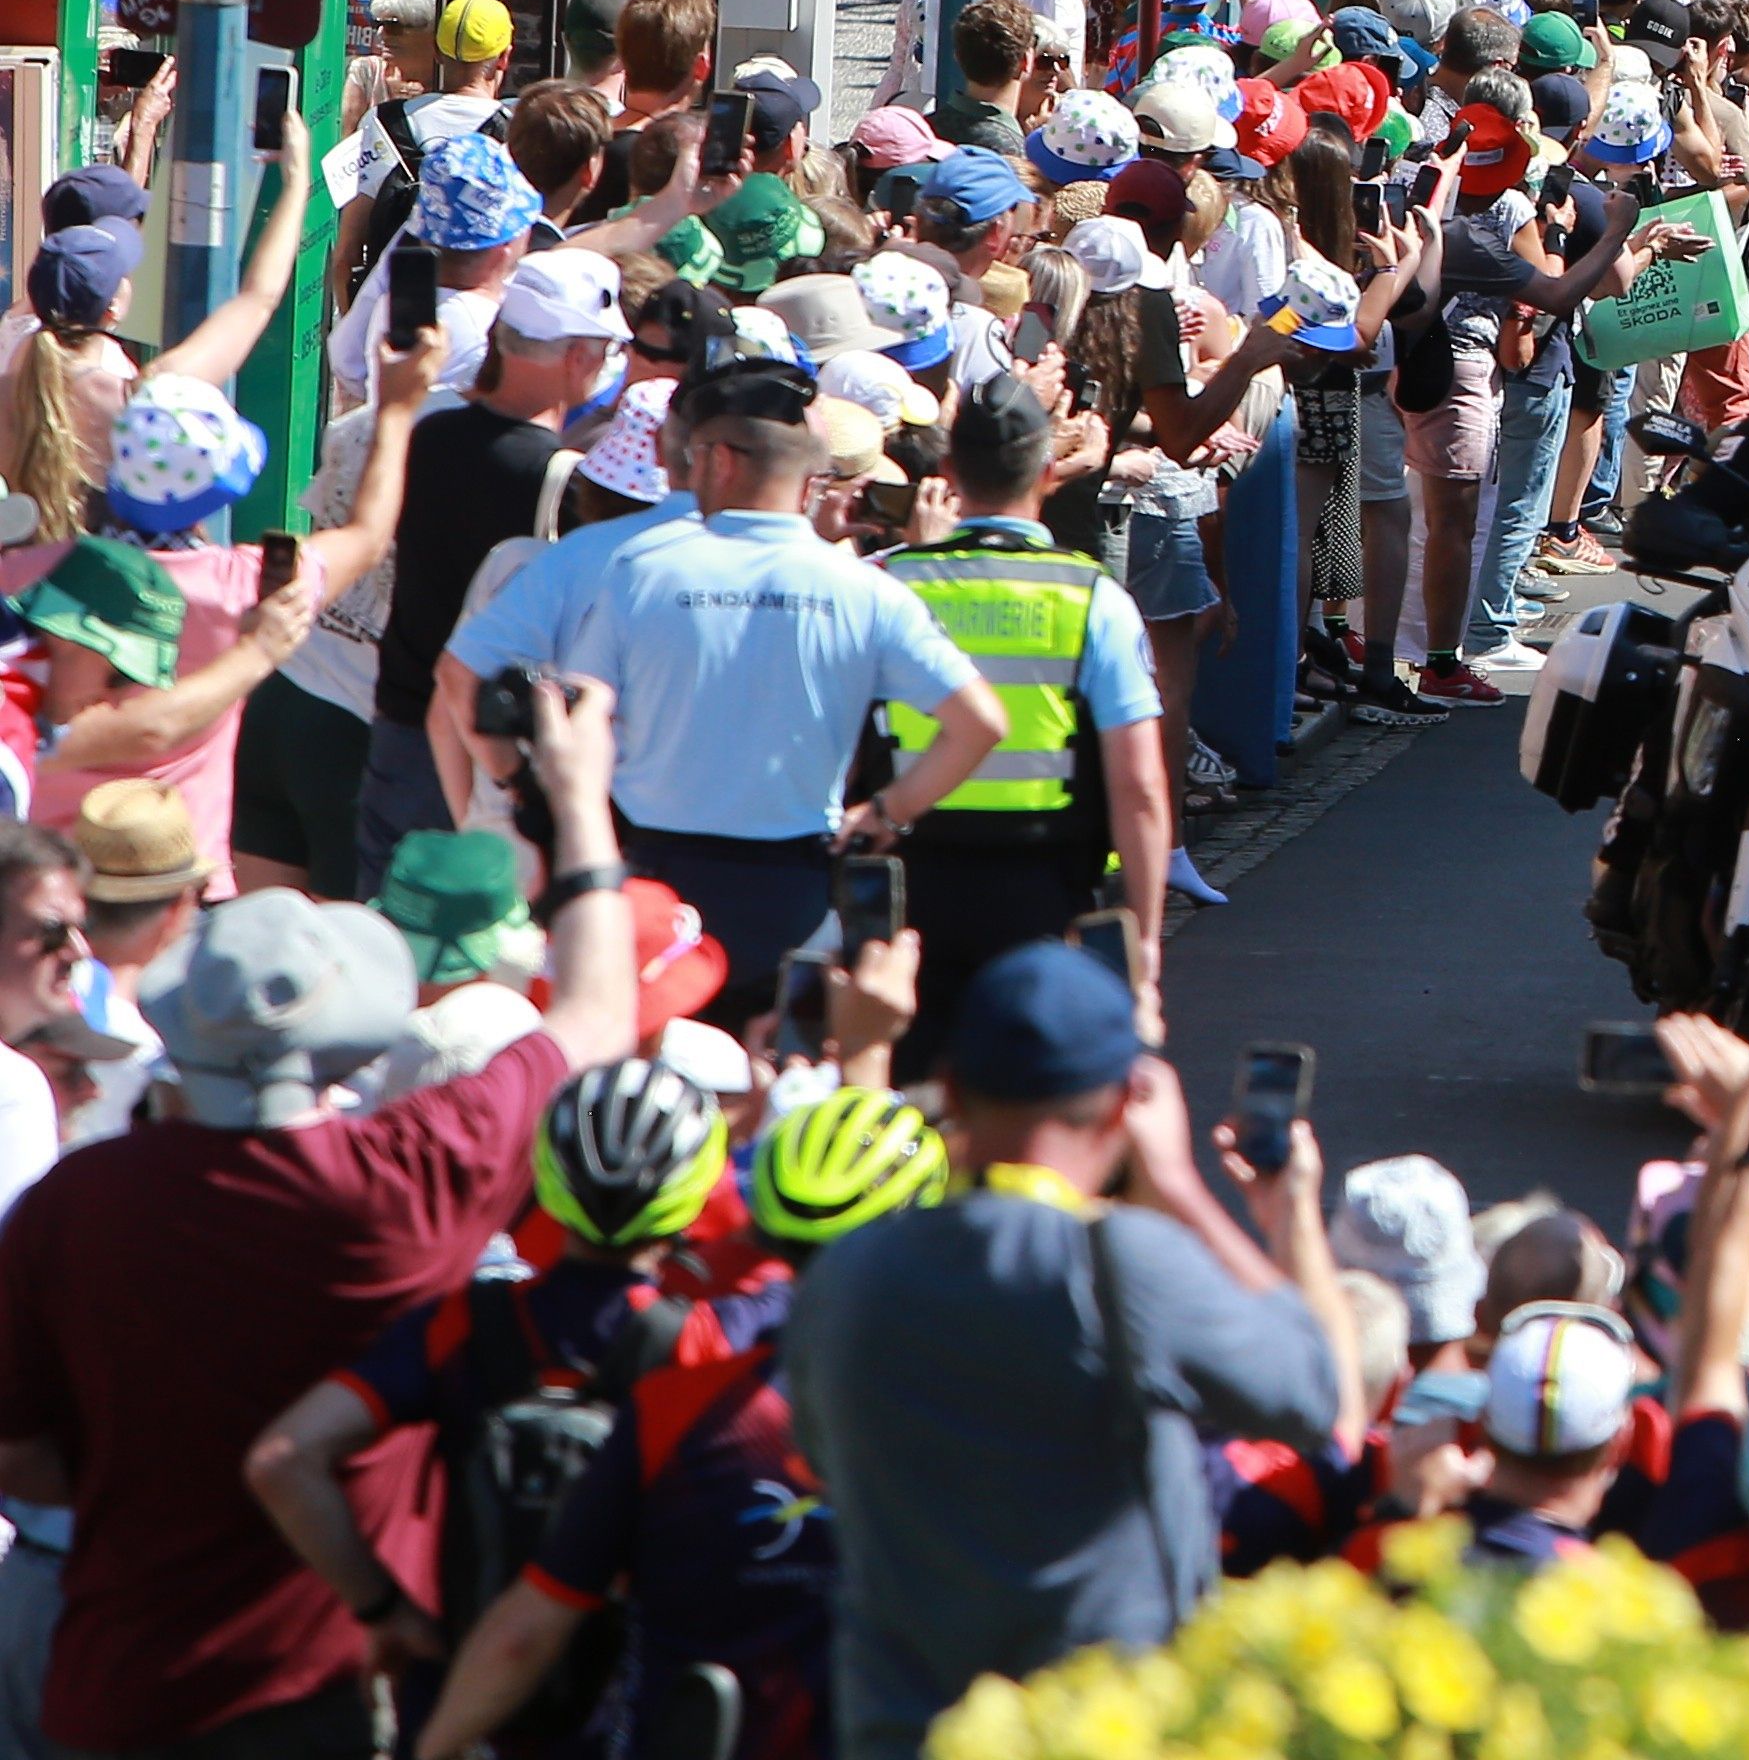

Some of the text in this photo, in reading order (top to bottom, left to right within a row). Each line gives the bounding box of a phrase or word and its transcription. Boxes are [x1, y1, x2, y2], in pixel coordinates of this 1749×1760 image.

[1618, 296, 1680, 318] Et gagnez une
[1650, 414, 1677, 429] AG2R
[675, 590, 835, 615] GENDARMERIE
